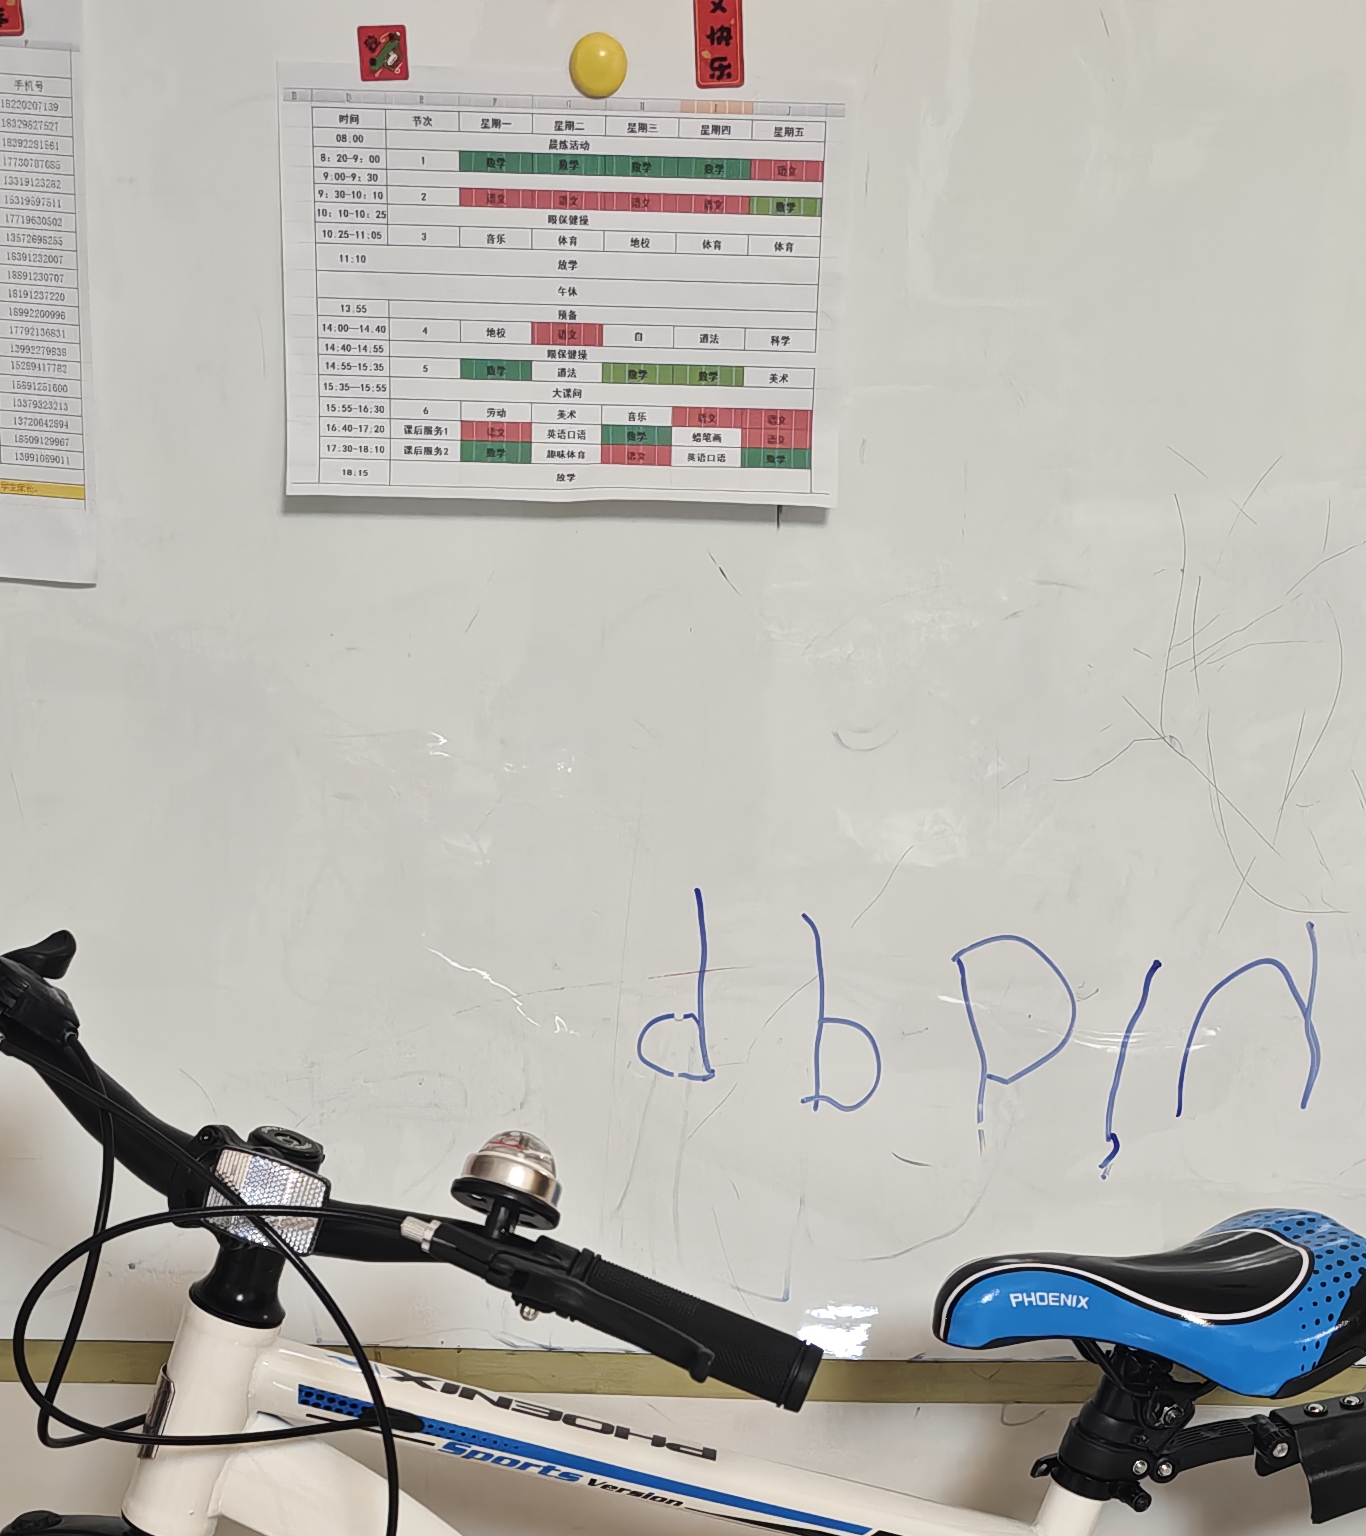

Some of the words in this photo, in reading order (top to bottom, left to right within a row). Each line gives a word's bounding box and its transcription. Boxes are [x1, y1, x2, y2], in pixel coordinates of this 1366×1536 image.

[14, 81, 43, 93] 手机号
[336, 114, 359, 128] 时间
[409, 116, 432, 130] 节次
[477, 118, 511, 132] 星期一
[554, 120, 584, 131] 星期二
[627, 122, 657, 133] 星期三
[701, 125, 731, 135] 星期四
[774, 127, 804, 137] 星期五
[487, 234, 505, 244] 音乐
[558, 236, 577, 246] 体育
[703, 239, 721, 250] 体育
[774, 242, 794, 252] 体育
[558, 260, 577, 270] 放学
[558, 286, 577, 296] 午休
[558, 311, 577, 322] 预备
[700, 334, 719, 344] 道法
[771, 336, 790, 346] 科学
[558, 368, 576, 378] 道法
[769, 373, 788, 383] 美术
[487, 408, 506, 418] 劳动
[557, 410, 576, 420] 美术
[628, 412, 646, 422] 音乐
[547, 429, 586, 440] 英语口语
[687, 453, 726, 462] 英语口语
[556, 473, 575, 482] 放学
[1010, 1289, 1090, 1310] PHOENIX
[442, 1439, 584, 1489] Sports
[585, 1475, 684, 1507] Version
